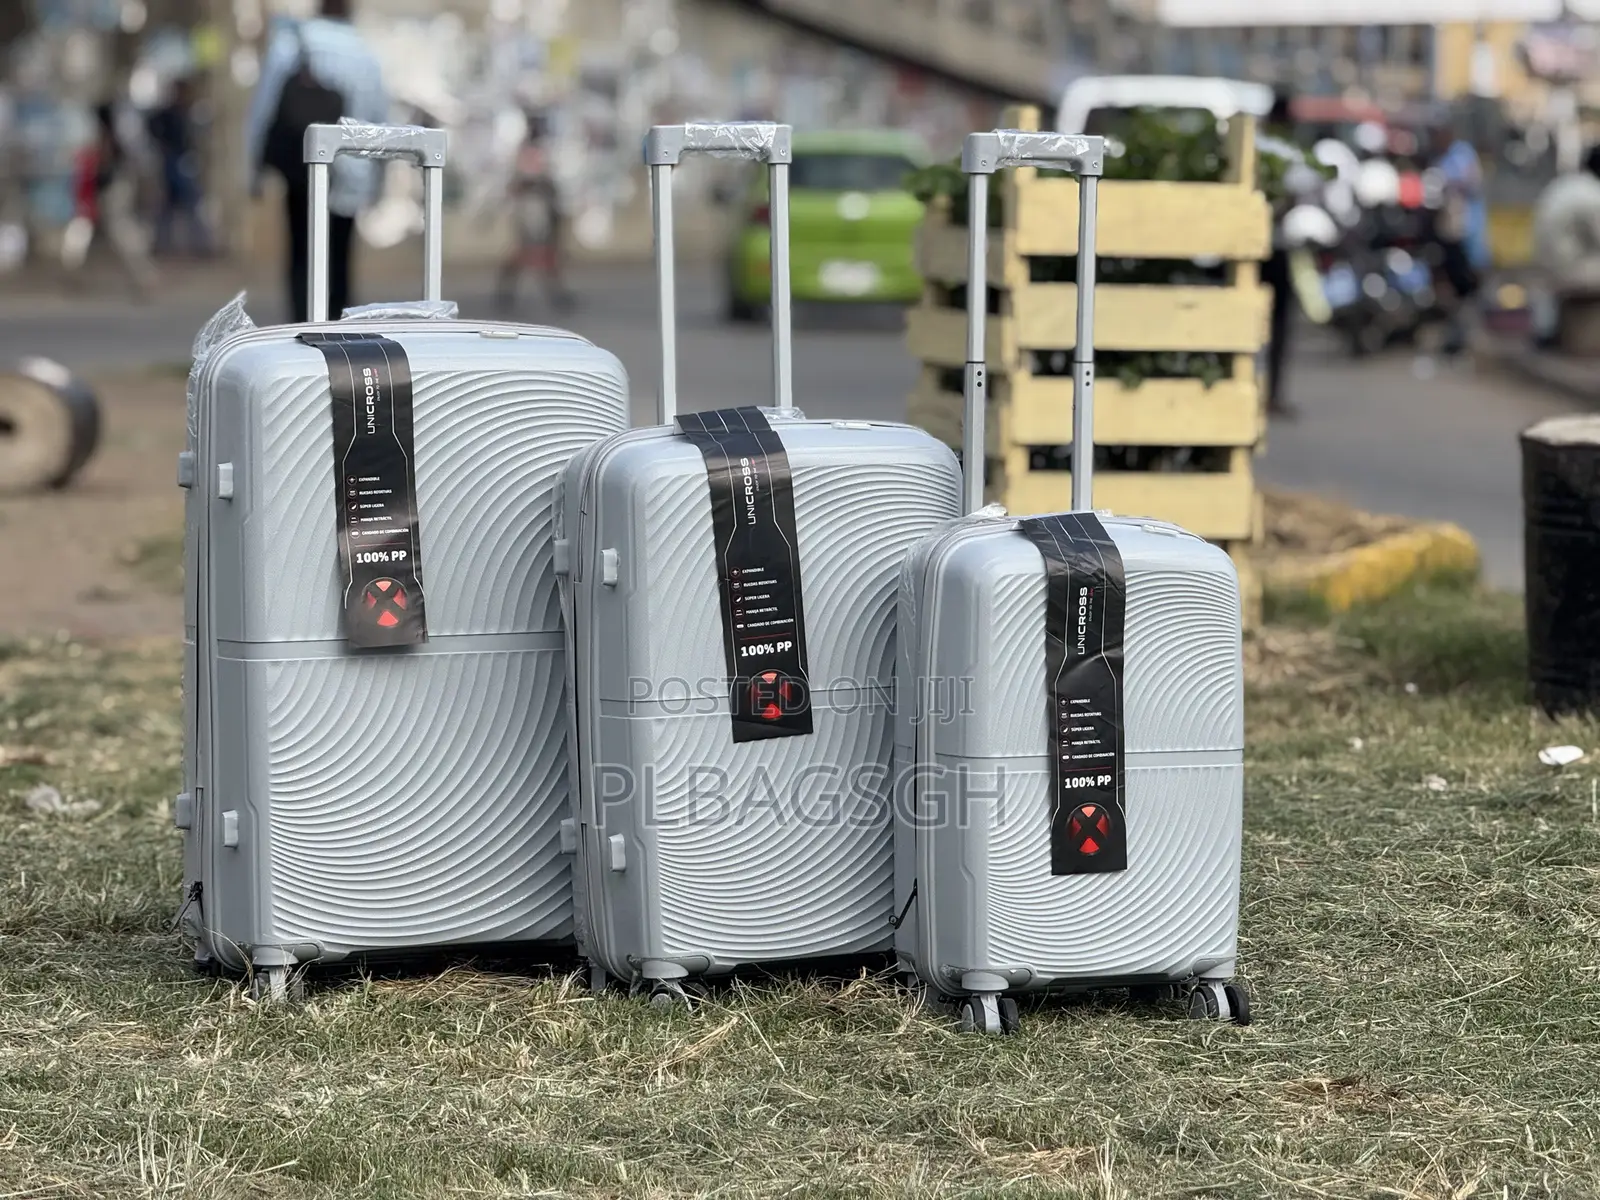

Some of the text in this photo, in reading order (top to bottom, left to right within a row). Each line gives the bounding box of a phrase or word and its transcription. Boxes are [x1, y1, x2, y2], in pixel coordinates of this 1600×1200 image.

[363, 368, 376, 434] UNICROSS
[741, 457, 756, 525] UNICROSS
[356, 550, 407, 564] 100% PP
[1077, 586, 1088, 655] UNICROSS
[741, 641, 792, 657] 100% PP
[1064, 775, 1112, 788] 100% PP
